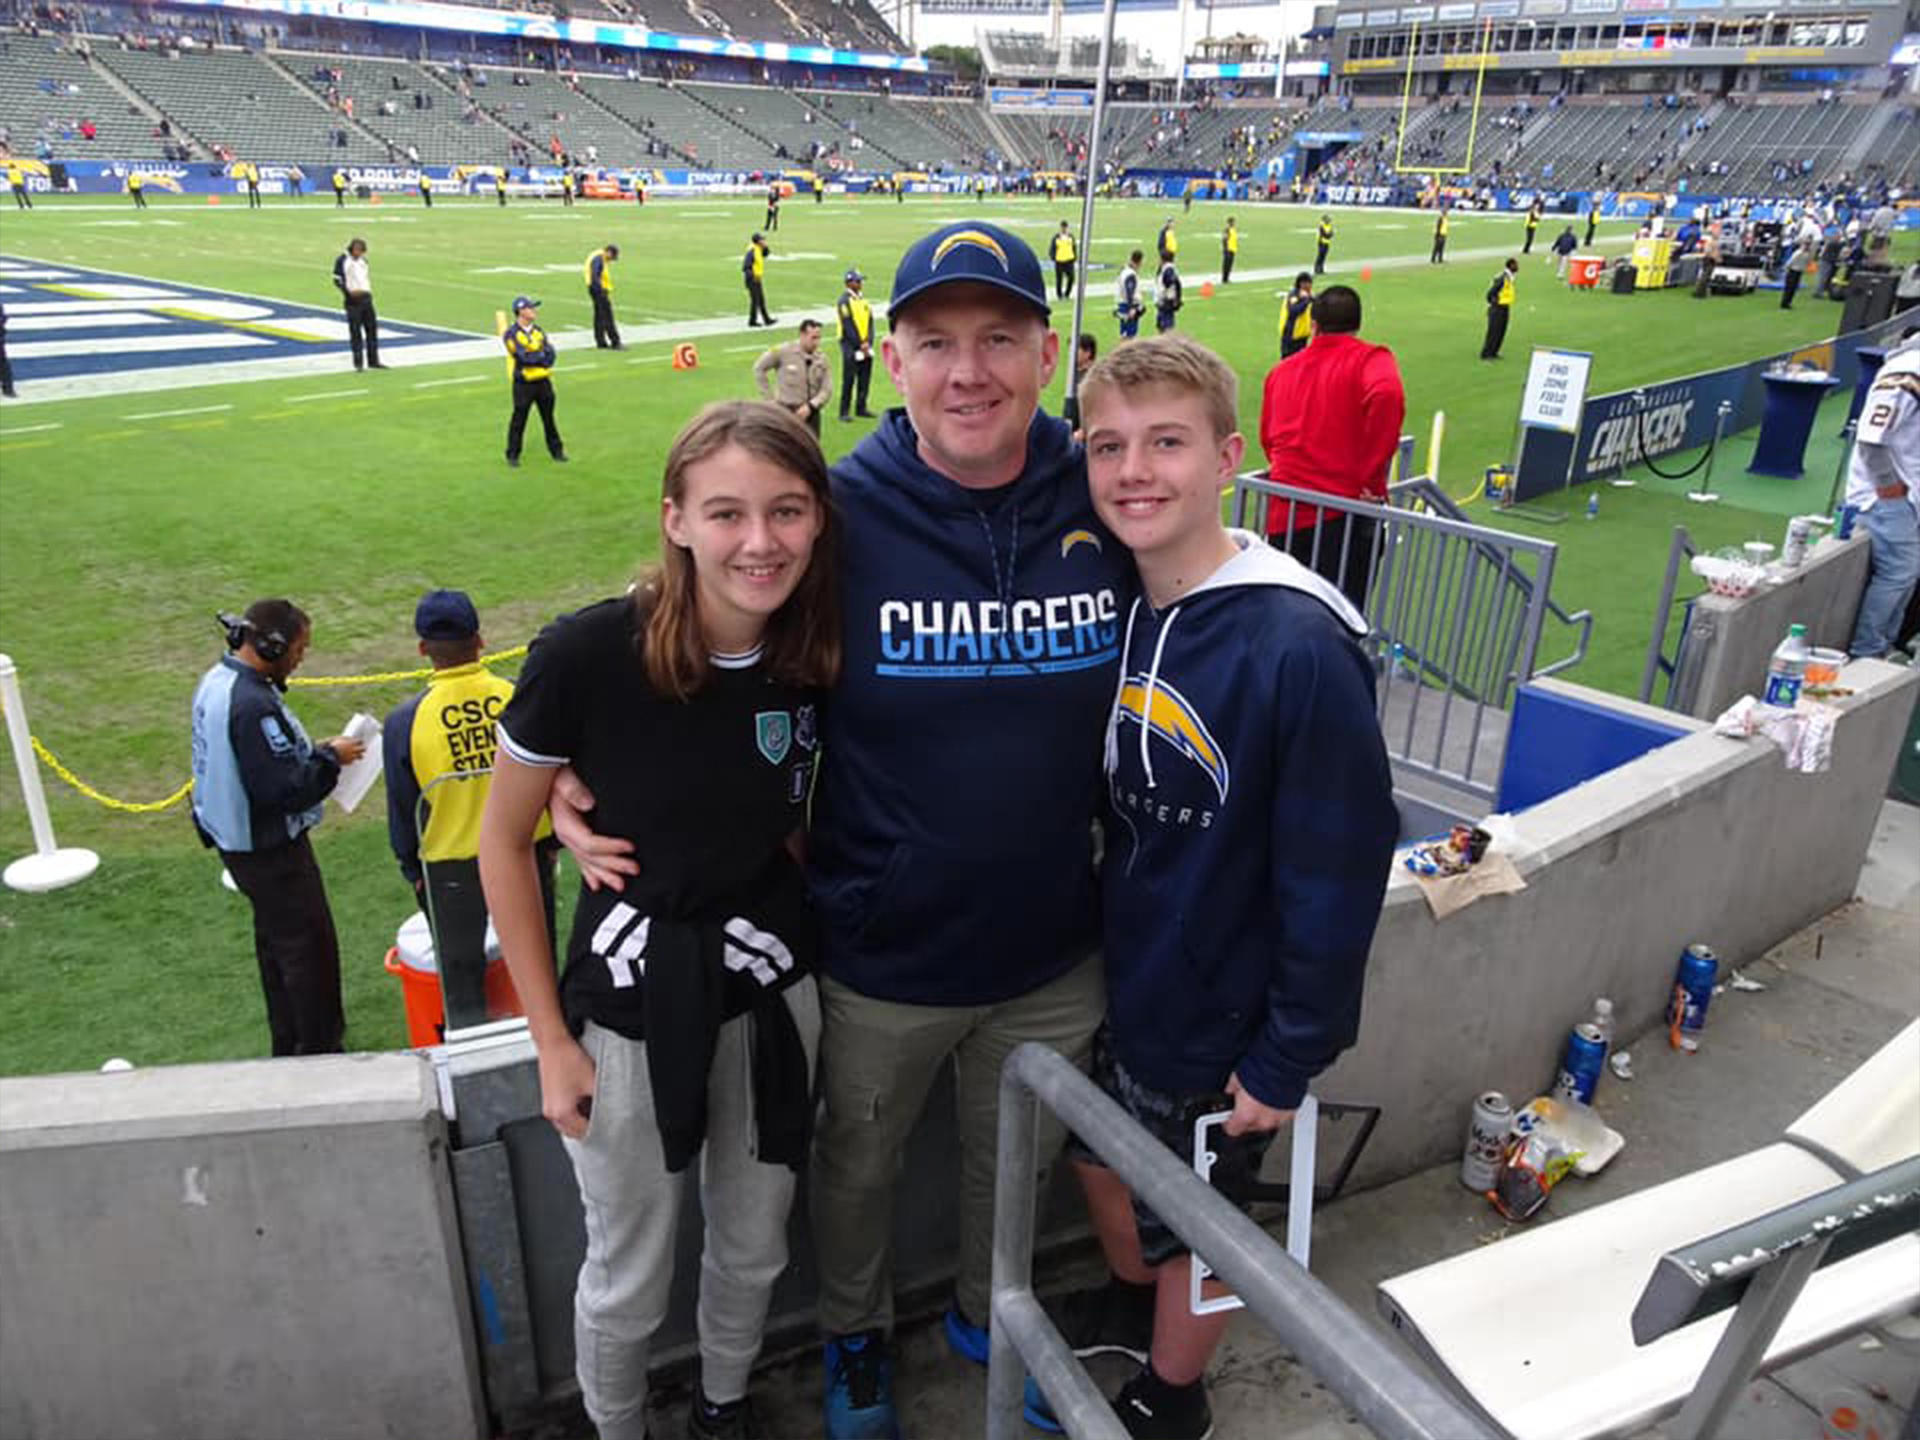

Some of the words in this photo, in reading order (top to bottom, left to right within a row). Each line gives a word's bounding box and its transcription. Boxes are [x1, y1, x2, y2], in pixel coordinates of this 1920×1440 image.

[680, 345, 697, 368] G
[1549, 364, 1568, 375] END
[879, 589, 1118, 661] CHARGERS
[441, 696, 503, 730] CSC
[447, 722, 498, 757] EVEN
